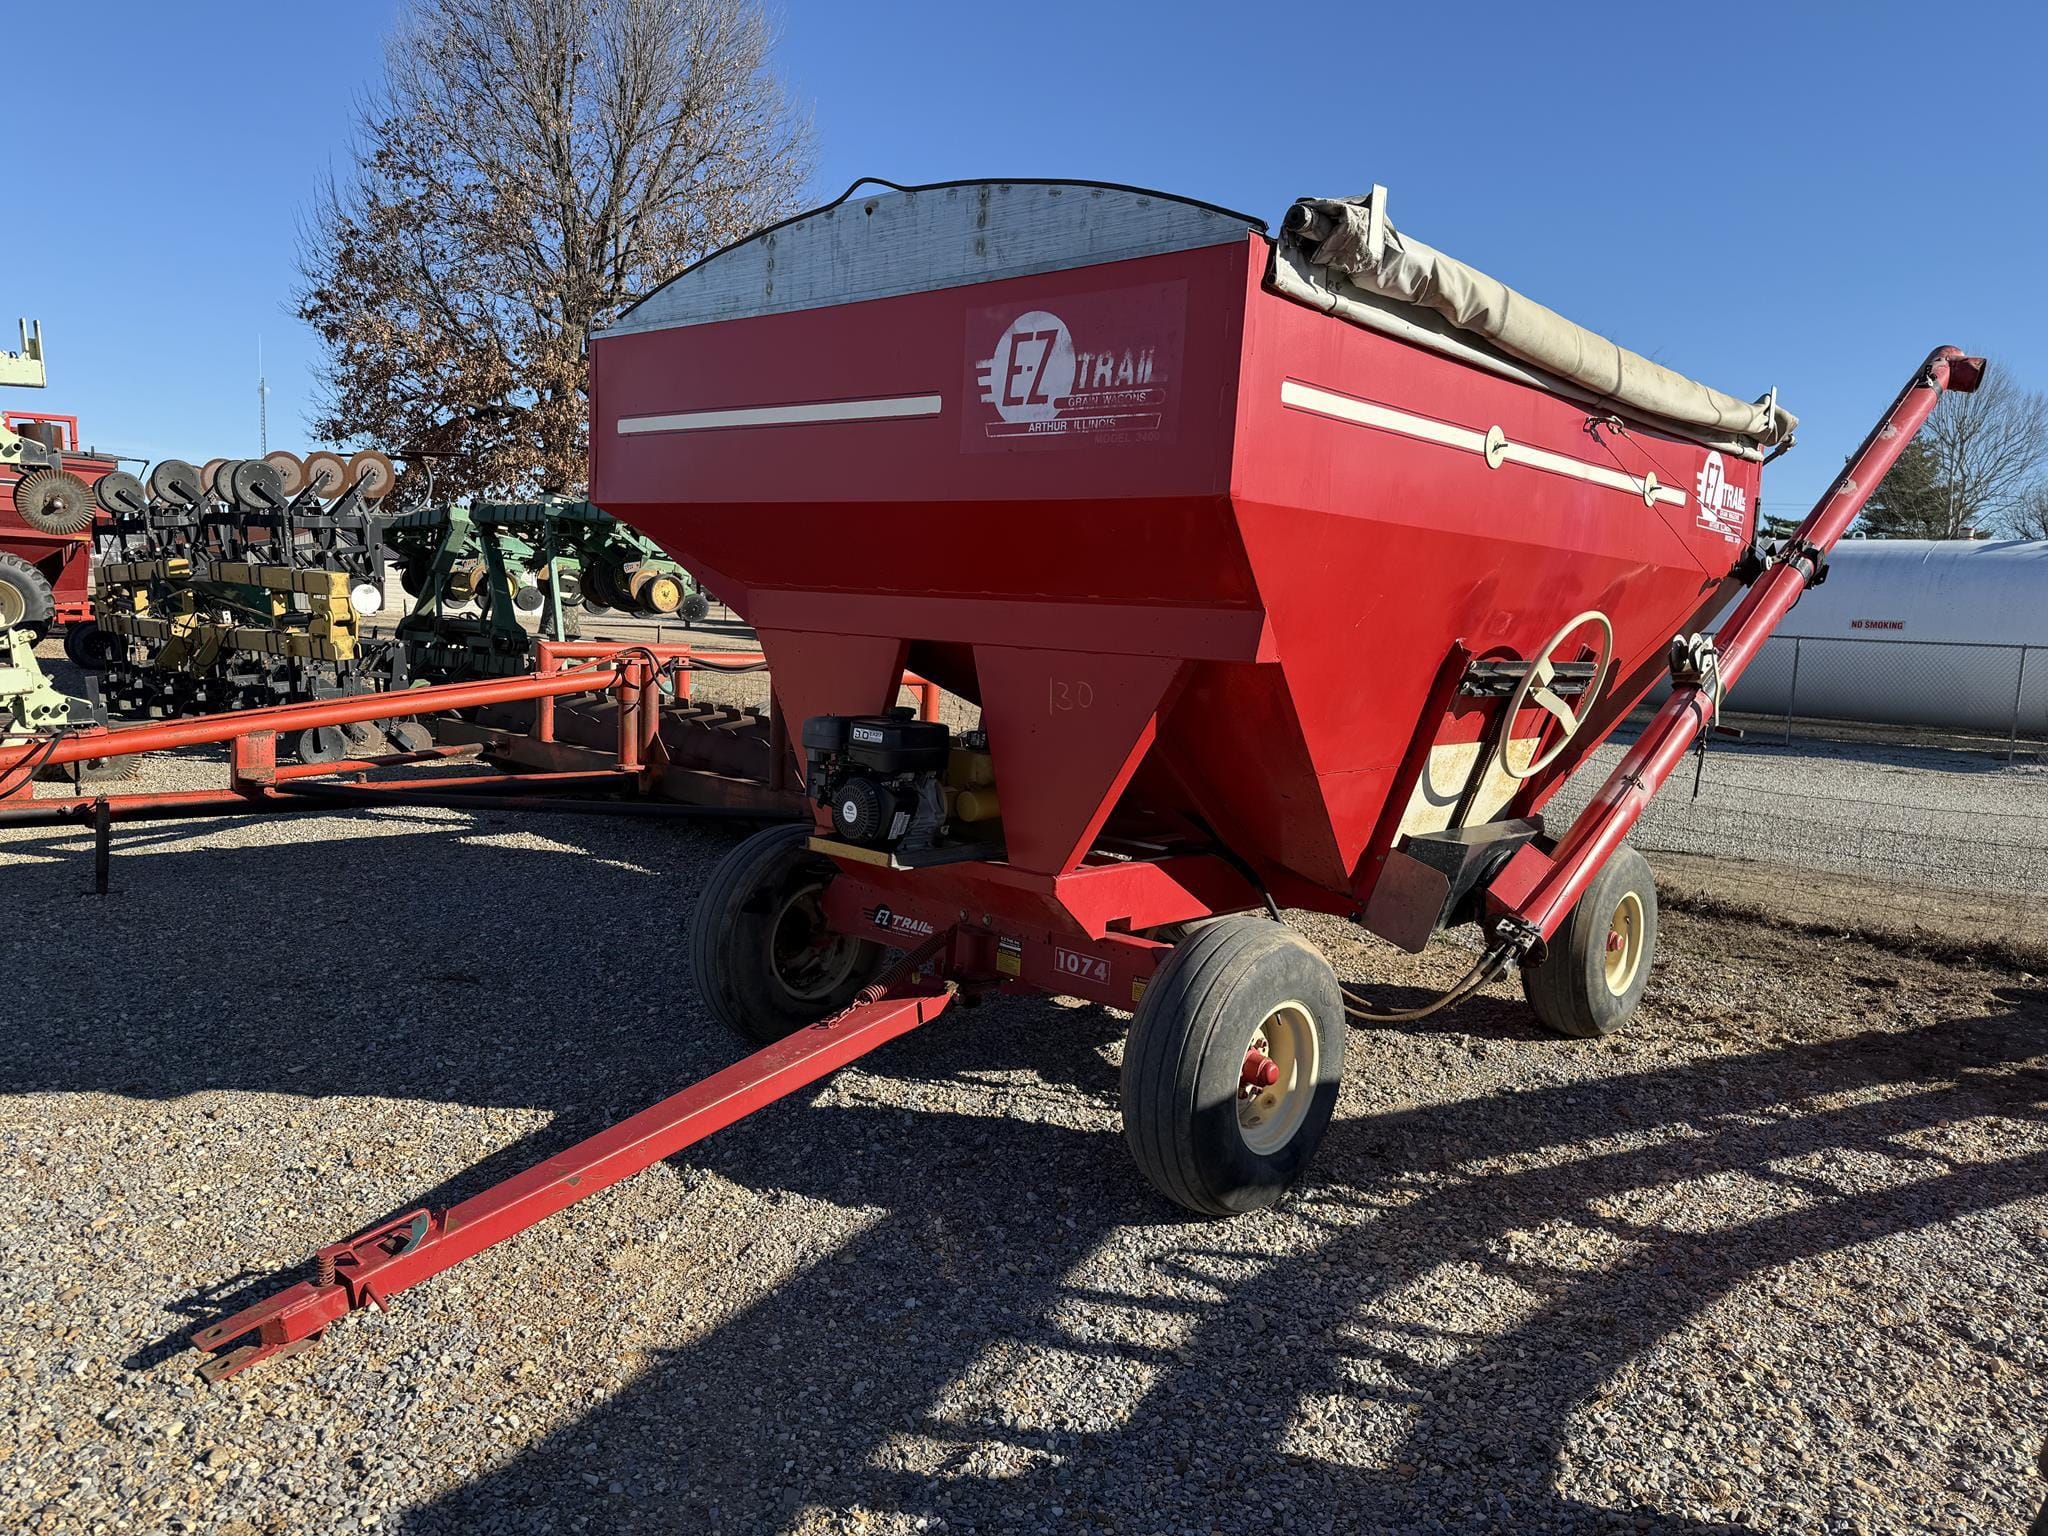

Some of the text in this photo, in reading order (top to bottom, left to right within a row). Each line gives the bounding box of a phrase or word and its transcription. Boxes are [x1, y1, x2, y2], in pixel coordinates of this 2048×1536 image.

[1028, 418, 1117, 433] ARTHUR ILLINOIS
[1851, 620, 1904, 630] NO SMOKING
[1058, 953, 1108, 981] 1074
